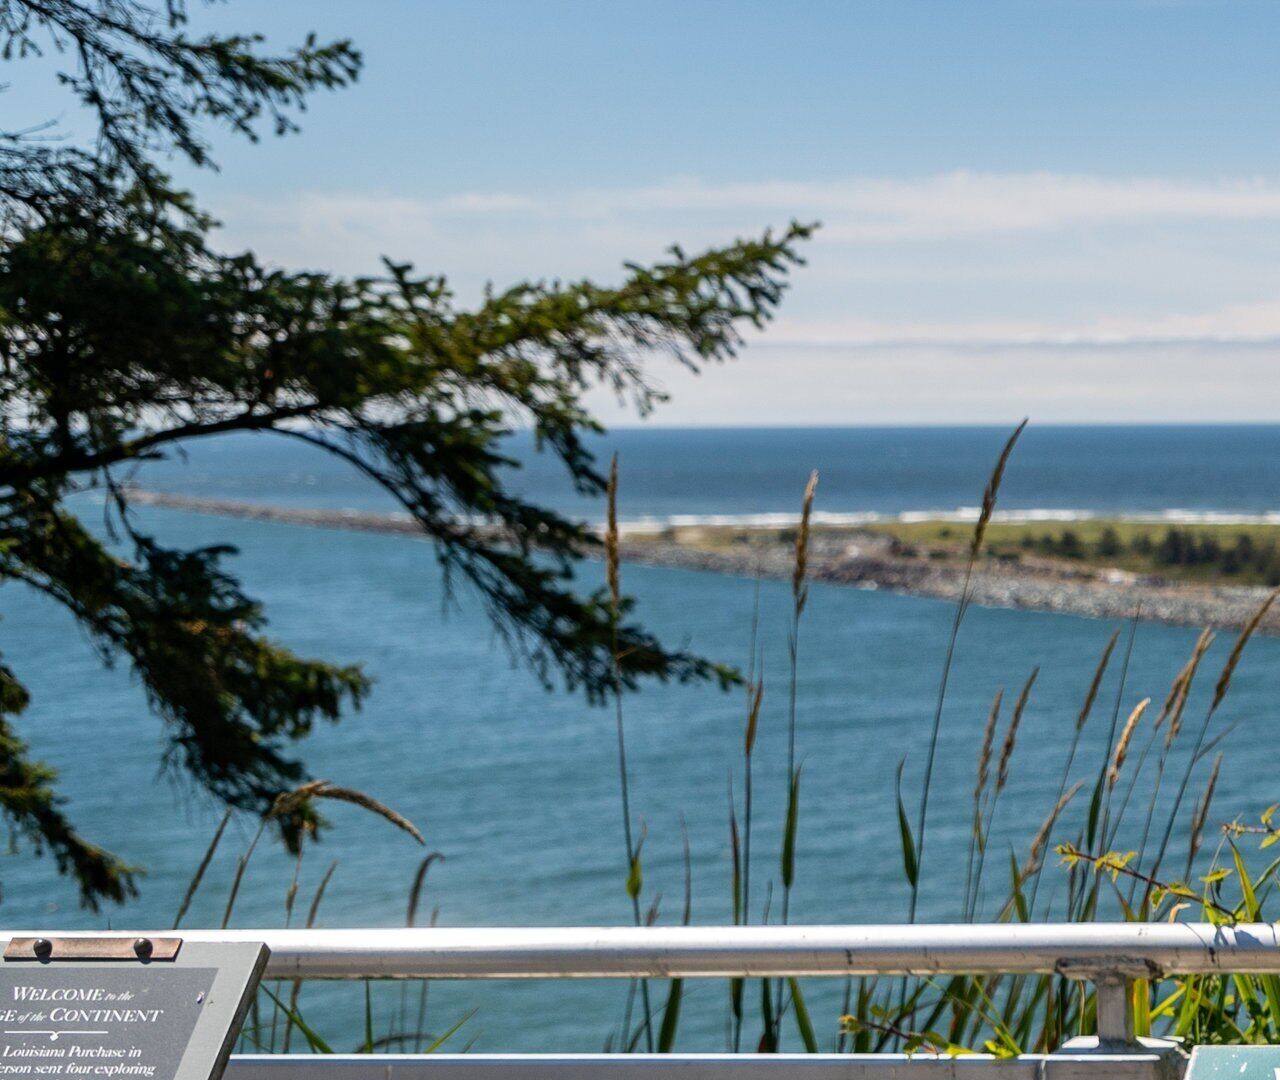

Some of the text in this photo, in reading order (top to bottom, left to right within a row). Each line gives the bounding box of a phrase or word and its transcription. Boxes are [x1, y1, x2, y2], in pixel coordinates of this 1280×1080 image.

[14, 987, 105, 1000] WELCOME
[118, 991, 135, 1000] the
[17, 1012, 30, 1024] of
[31, 1011, 47, 1022] the
[50, 1008, 164, 1022] CONTINENT
[3, 1043, 141, 1057] Louisiana Purchase in
[34, 1065, 63, 1074] sent
[65, 1063, 93, 1074] four
[95, 1063, 156, 1077] exploring
